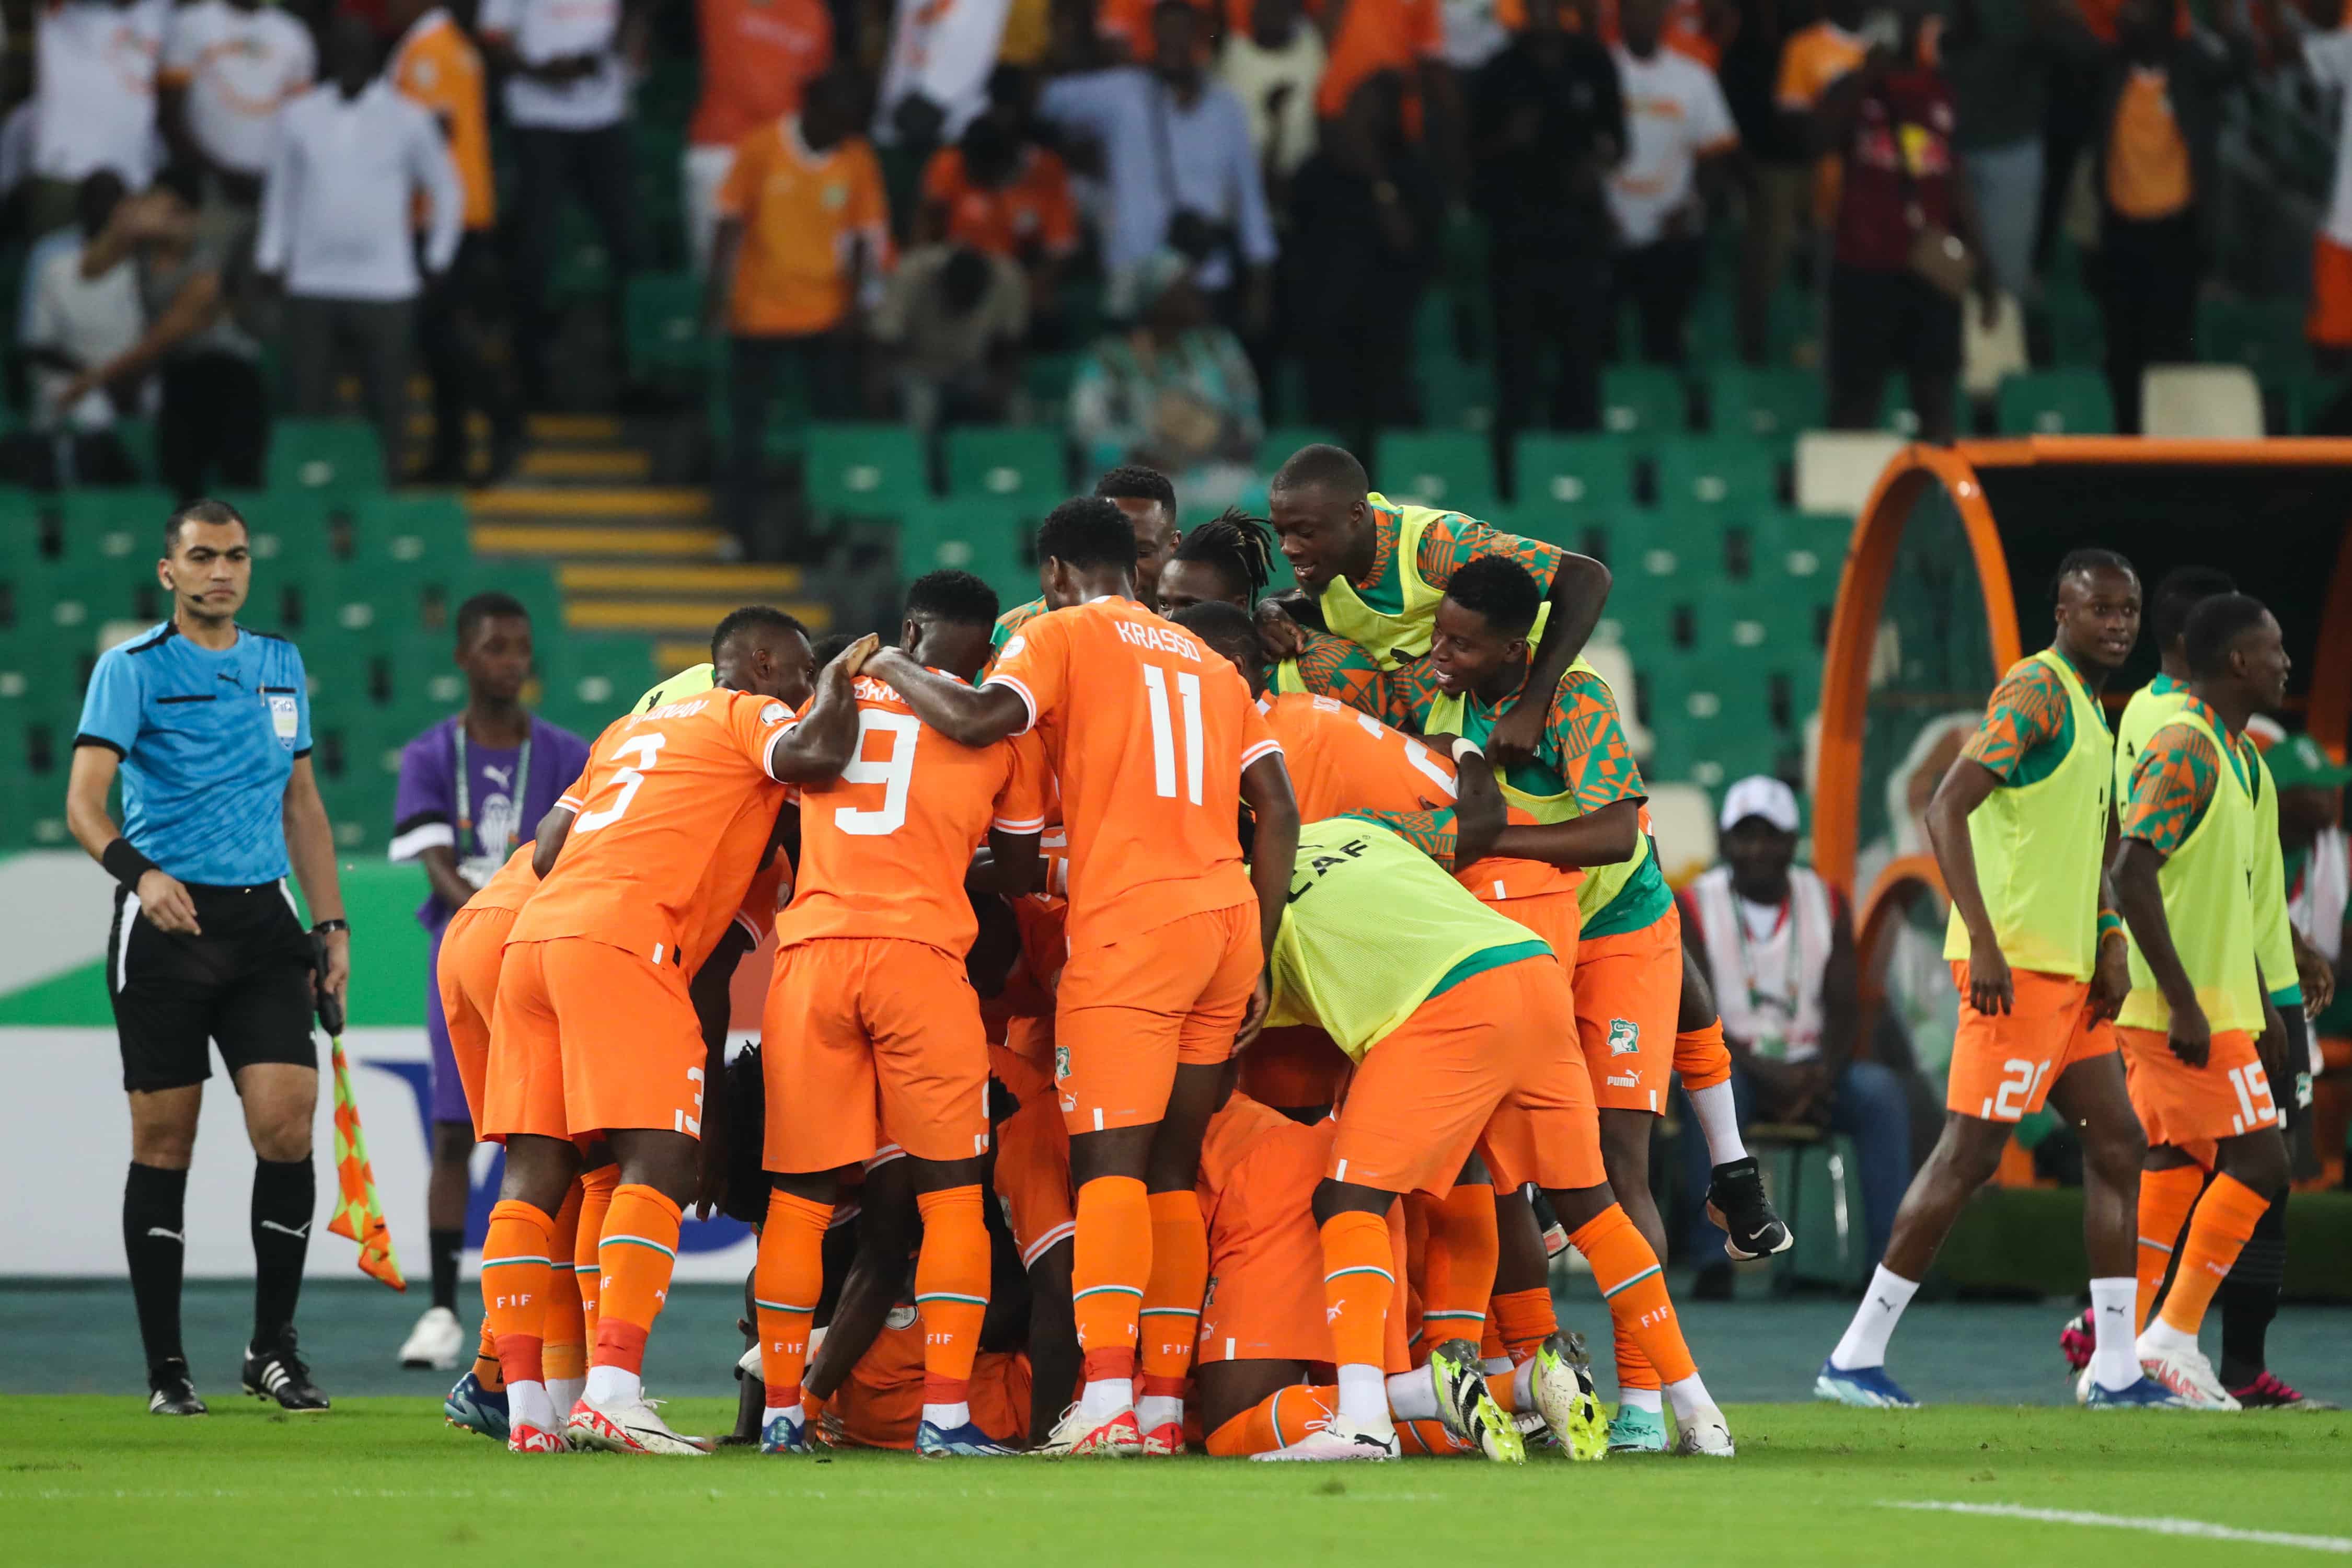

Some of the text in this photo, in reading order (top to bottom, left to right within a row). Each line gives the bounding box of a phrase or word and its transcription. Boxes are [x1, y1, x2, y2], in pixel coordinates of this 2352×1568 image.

[1114, 620, 1202, 663] KRASSO
[1143, 663, 1204, 806] 11
[574, 732, 666, 834] 3
[835, 708, 921, 835] 9
[1607, 1075, 1635, 1088] PUMA
[2228, 1059, 2277, 1127] 15
[685, 1066, 705, 1136] 3
[497, 1294, 532, 1309] FIF
[1641, 1305, 1667, 1328] FIF
[774, 1342, 803, 1354] FIF
[927, 1333, 954, 1345] FIF
[1162, 1343, 1191, 1355] FIF
